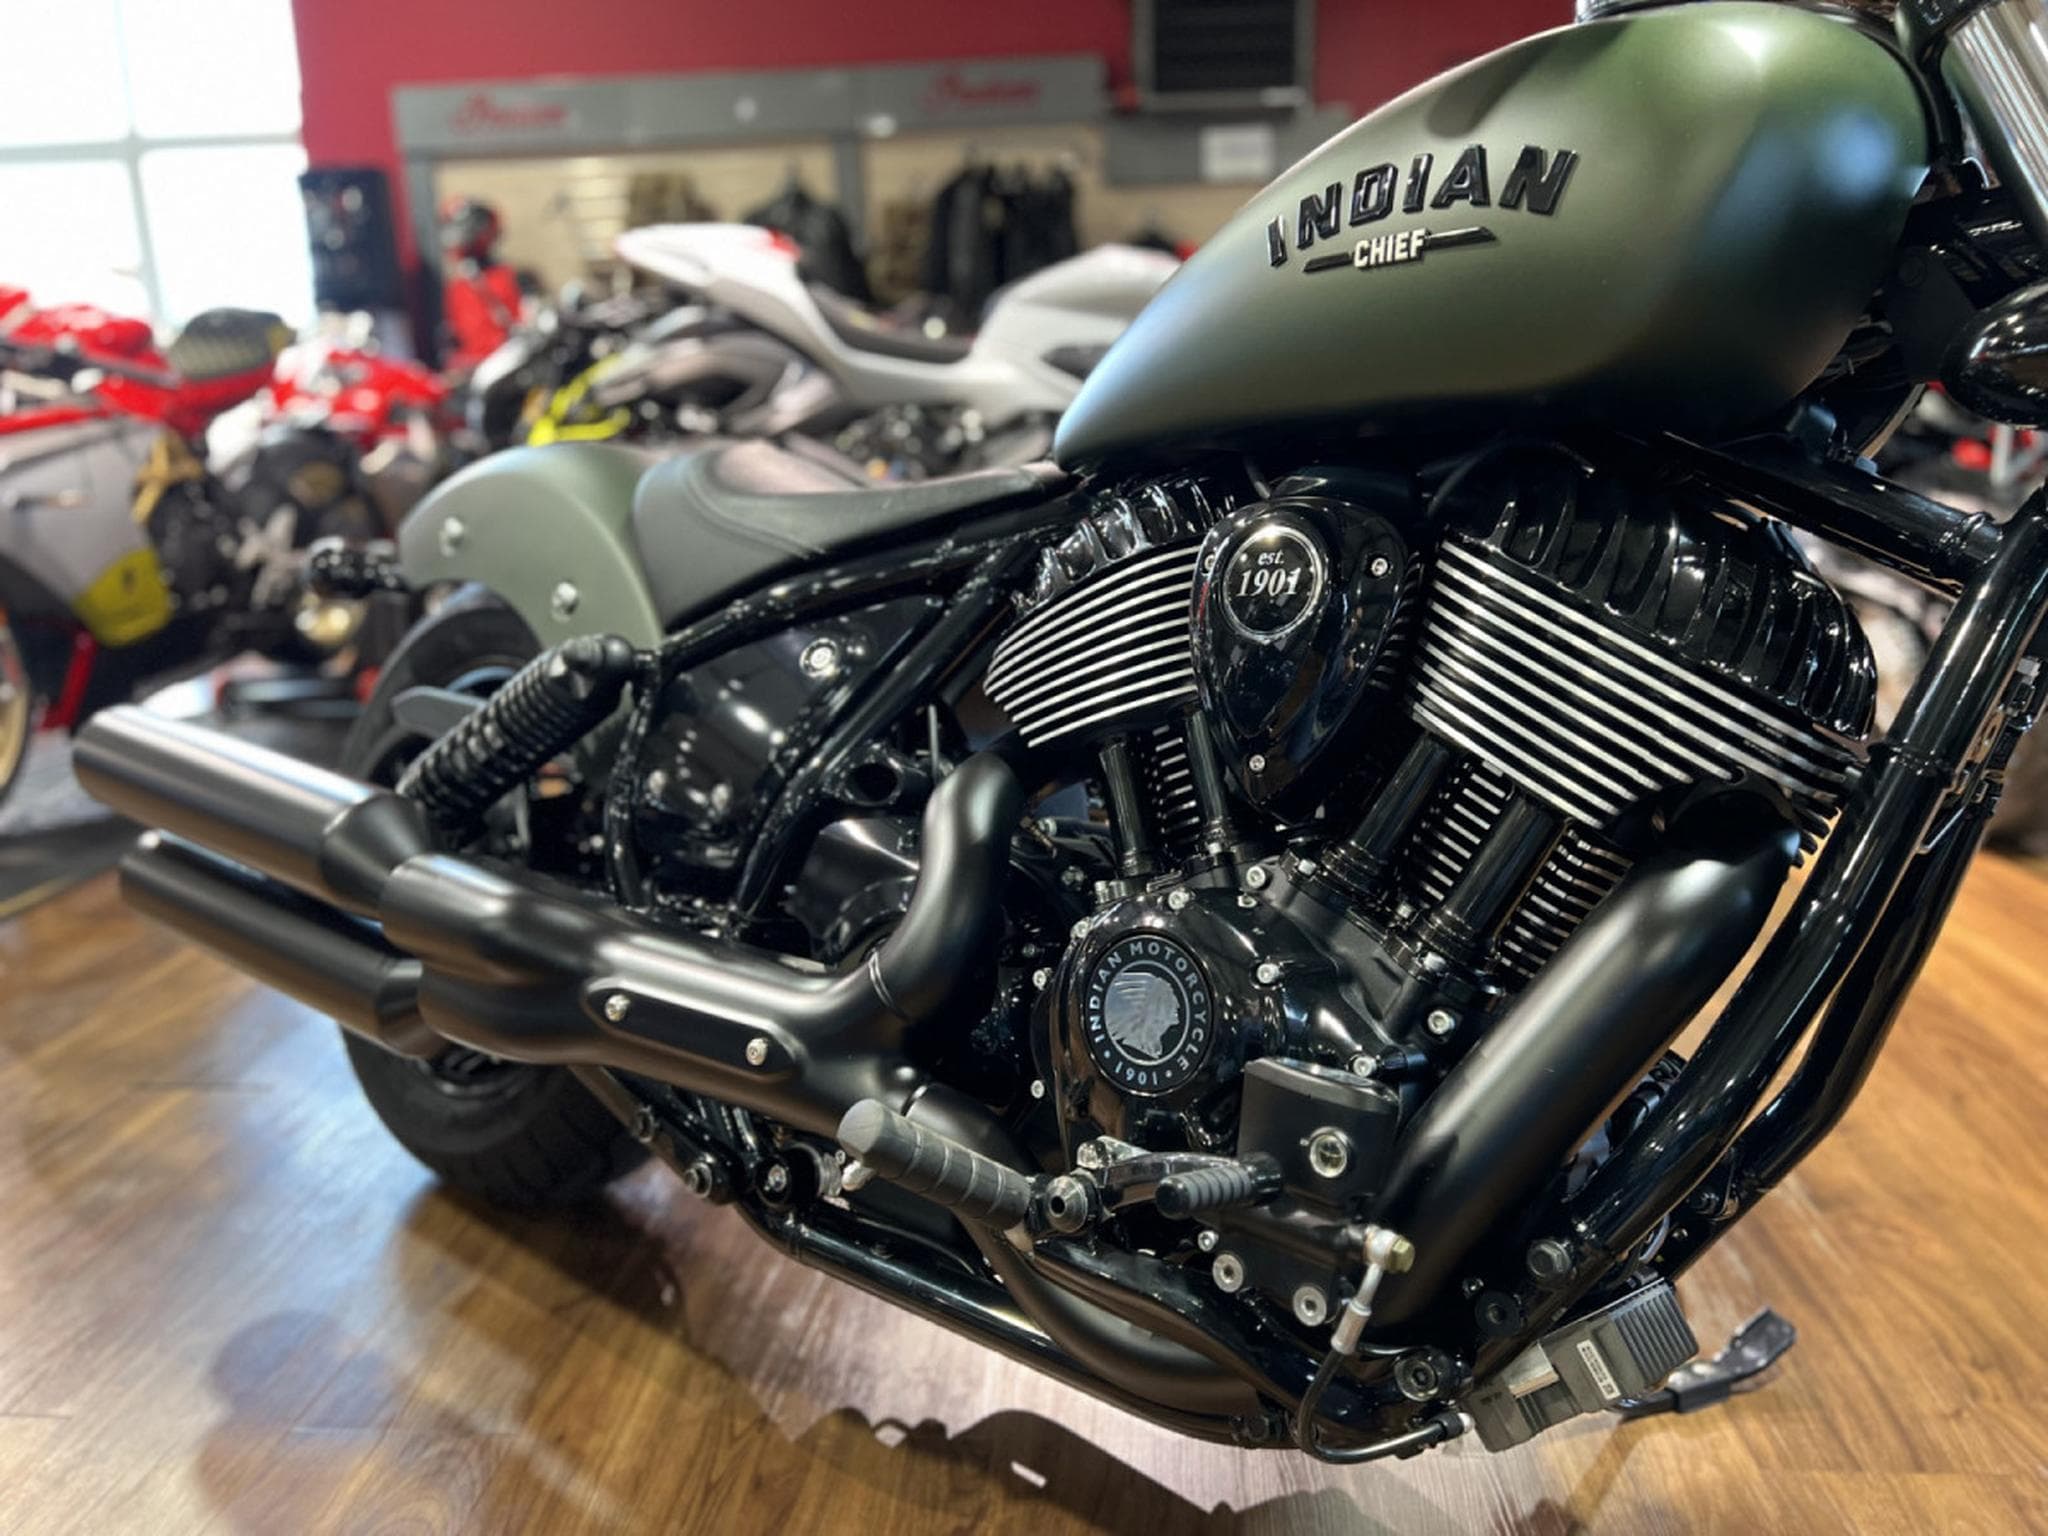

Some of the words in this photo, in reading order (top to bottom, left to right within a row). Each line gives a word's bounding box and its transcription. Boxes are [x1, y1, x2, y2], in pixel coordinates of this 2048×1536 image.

[1266, 143, 1578, 267] INDIAN
[1353, 227, 1427, 270] CHIEF
[1257, 549, 1285, 566] est.
[1236, 567, 1302, 597] 1901
[1089, 952, 1122, 1044] INDIAN
[1129, 941, 1207, 1071] MOTORCYCLE
[1115, 1061, 1158, 1086] 1901
